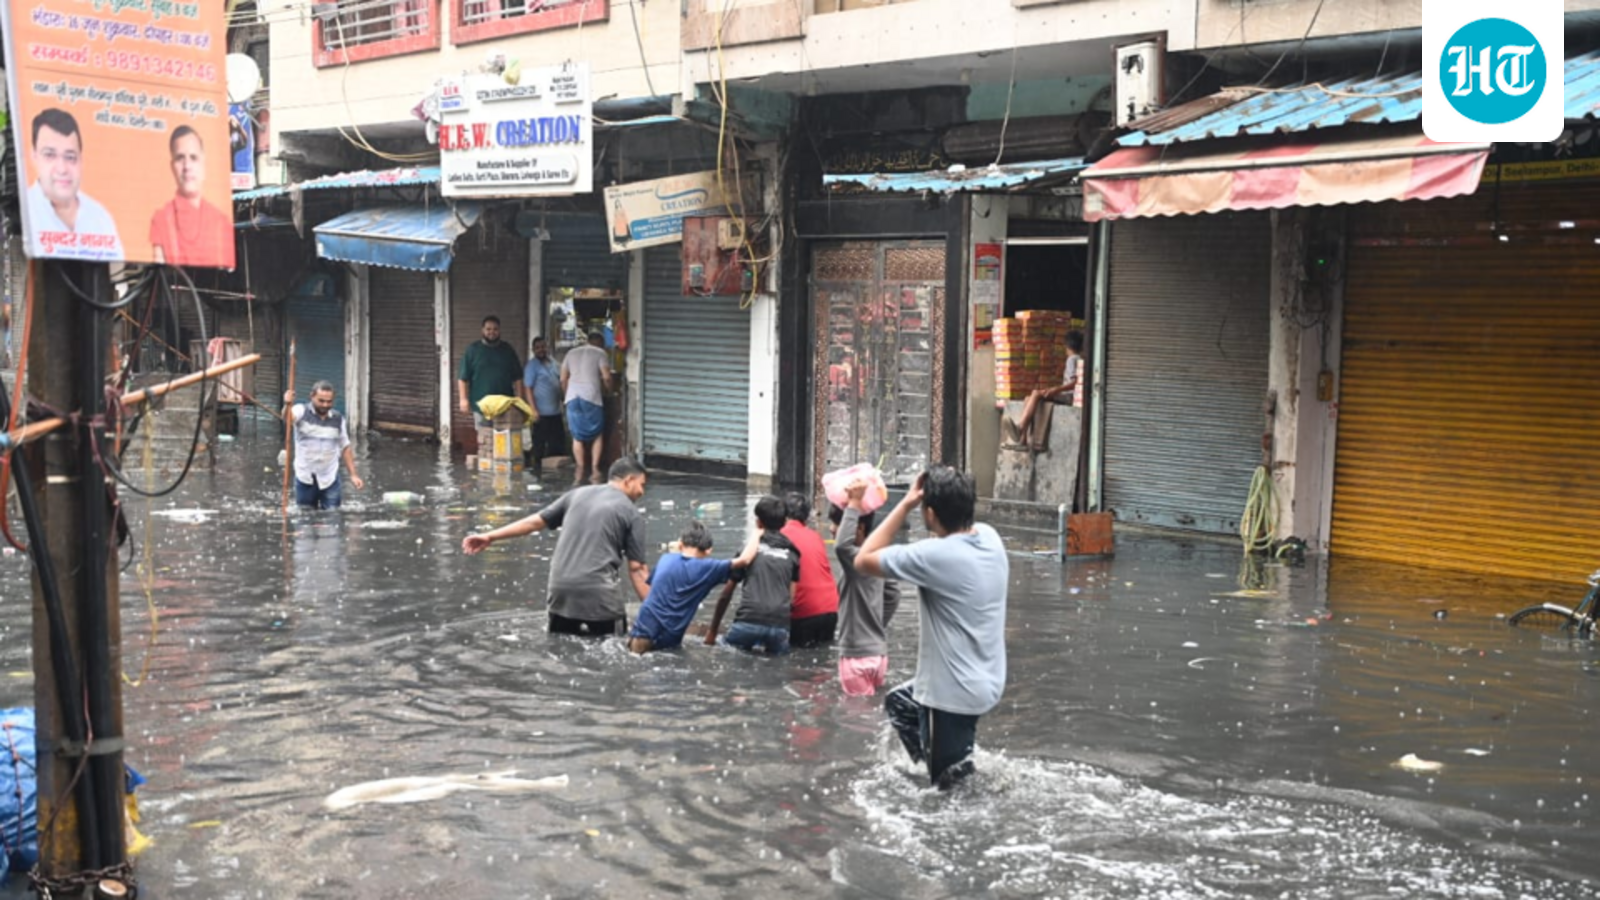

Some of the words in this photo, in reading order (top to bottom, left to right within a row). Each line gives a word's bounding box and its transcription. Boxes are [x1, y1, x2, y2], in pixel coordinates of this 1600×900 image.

[107, 50, 216, 81] 9891342146
[496, 115, 581, 146] CREATION
[660, 197, 702, 212] CREATION
[39, 230, 78, 254] सुन्दर
